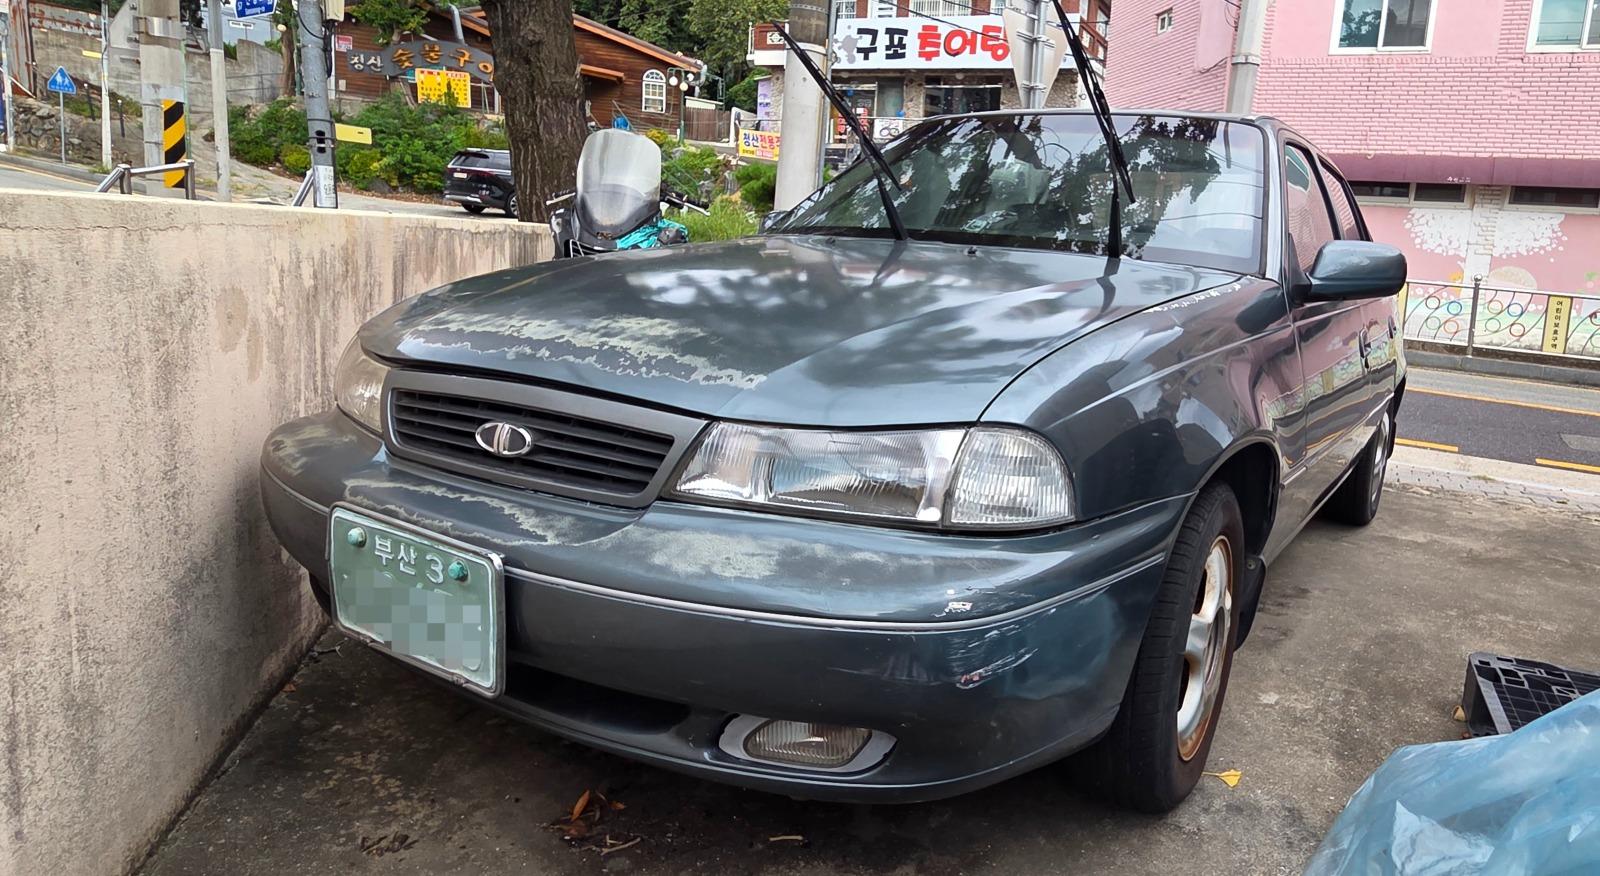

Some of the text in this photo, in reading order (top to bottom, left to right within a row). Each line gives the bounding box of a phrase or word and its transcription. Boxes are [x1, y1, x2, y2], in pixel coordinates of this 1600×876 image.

[856, 24, 1010, 62] 구포 추어탕
[1550, 300, 1563, 350] 어린이보호구역
[374, 533, 445, 584] 부산 3
